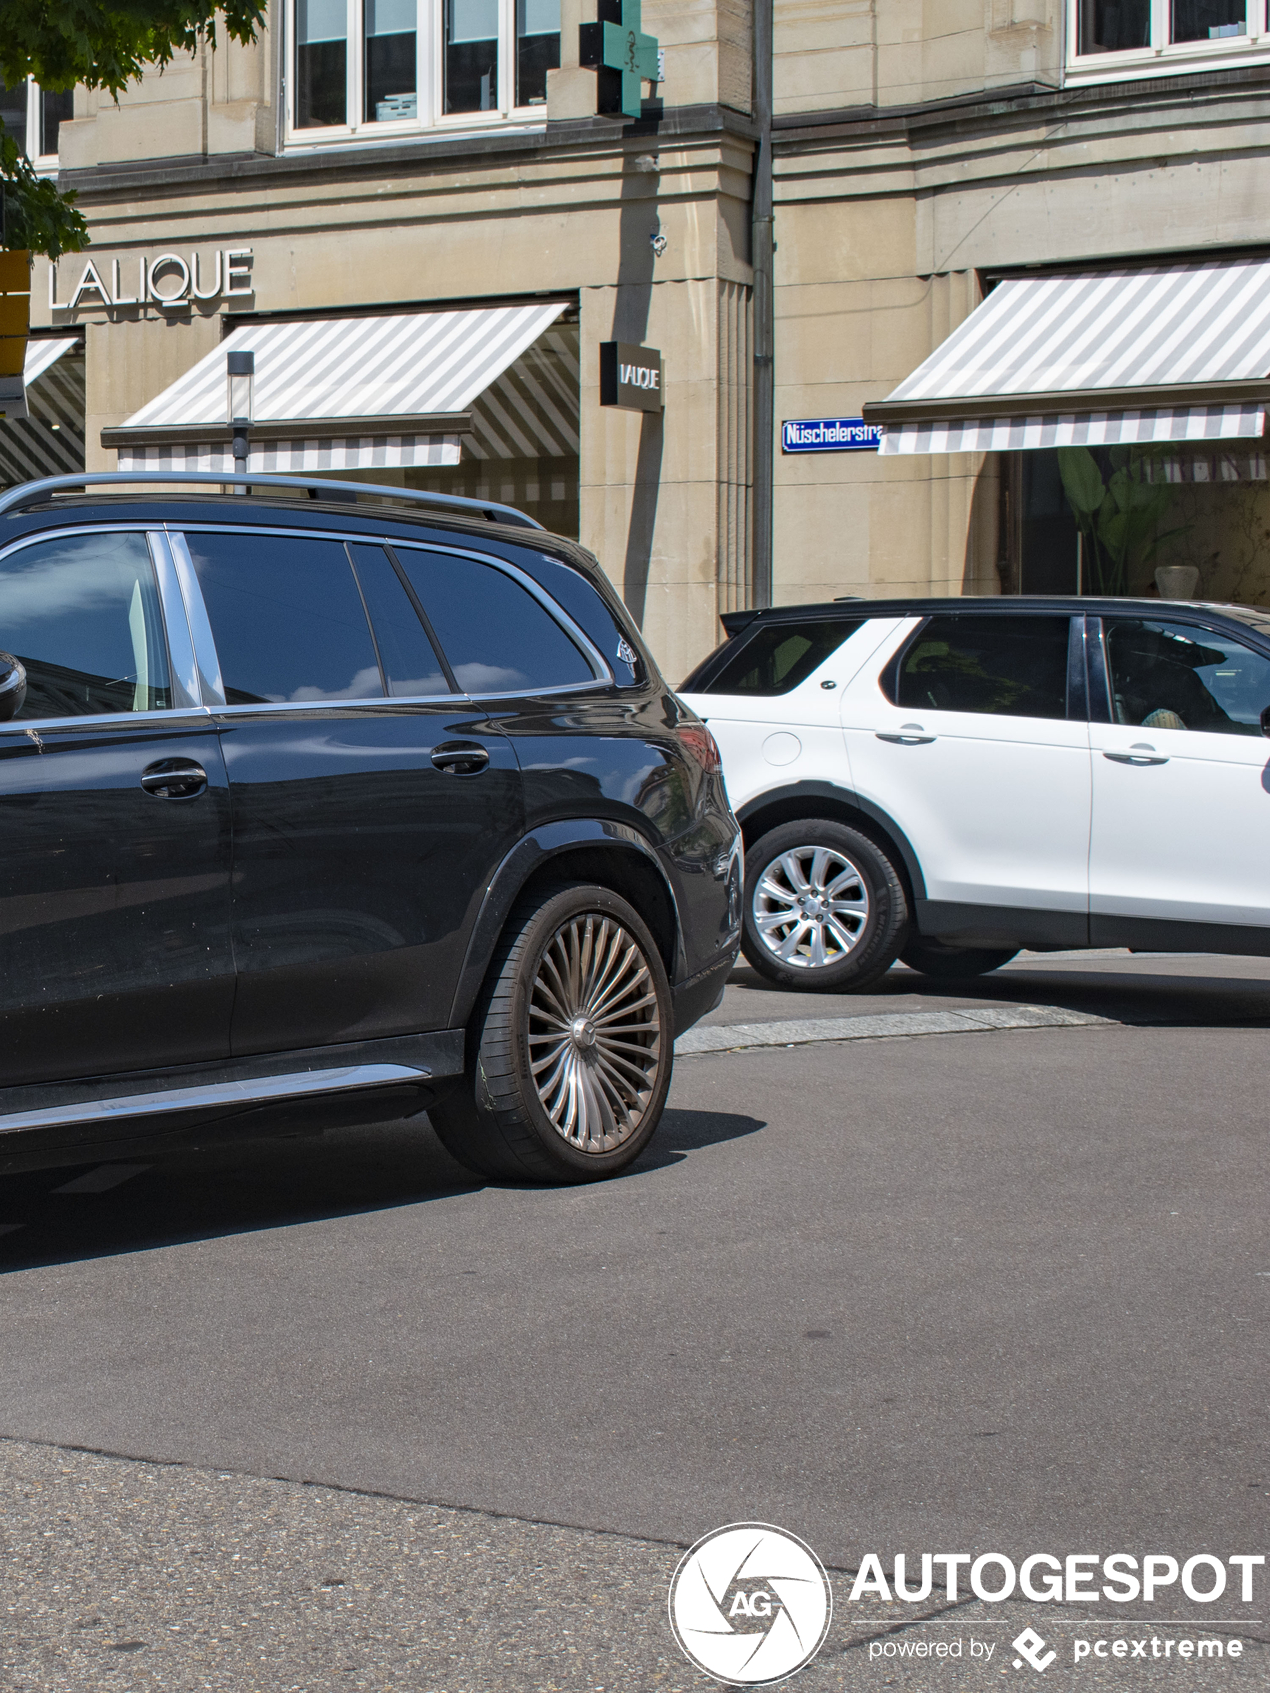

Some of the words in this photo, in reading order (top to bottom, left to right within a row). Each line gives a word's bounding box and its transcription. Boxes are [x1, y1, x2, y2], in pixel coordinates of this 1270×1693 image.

[48, 248, 253, 309] LALIQUE
[619, 363, 660, 390] LALIQUE
[786, 421, 883, 445] Nüschelerstra
